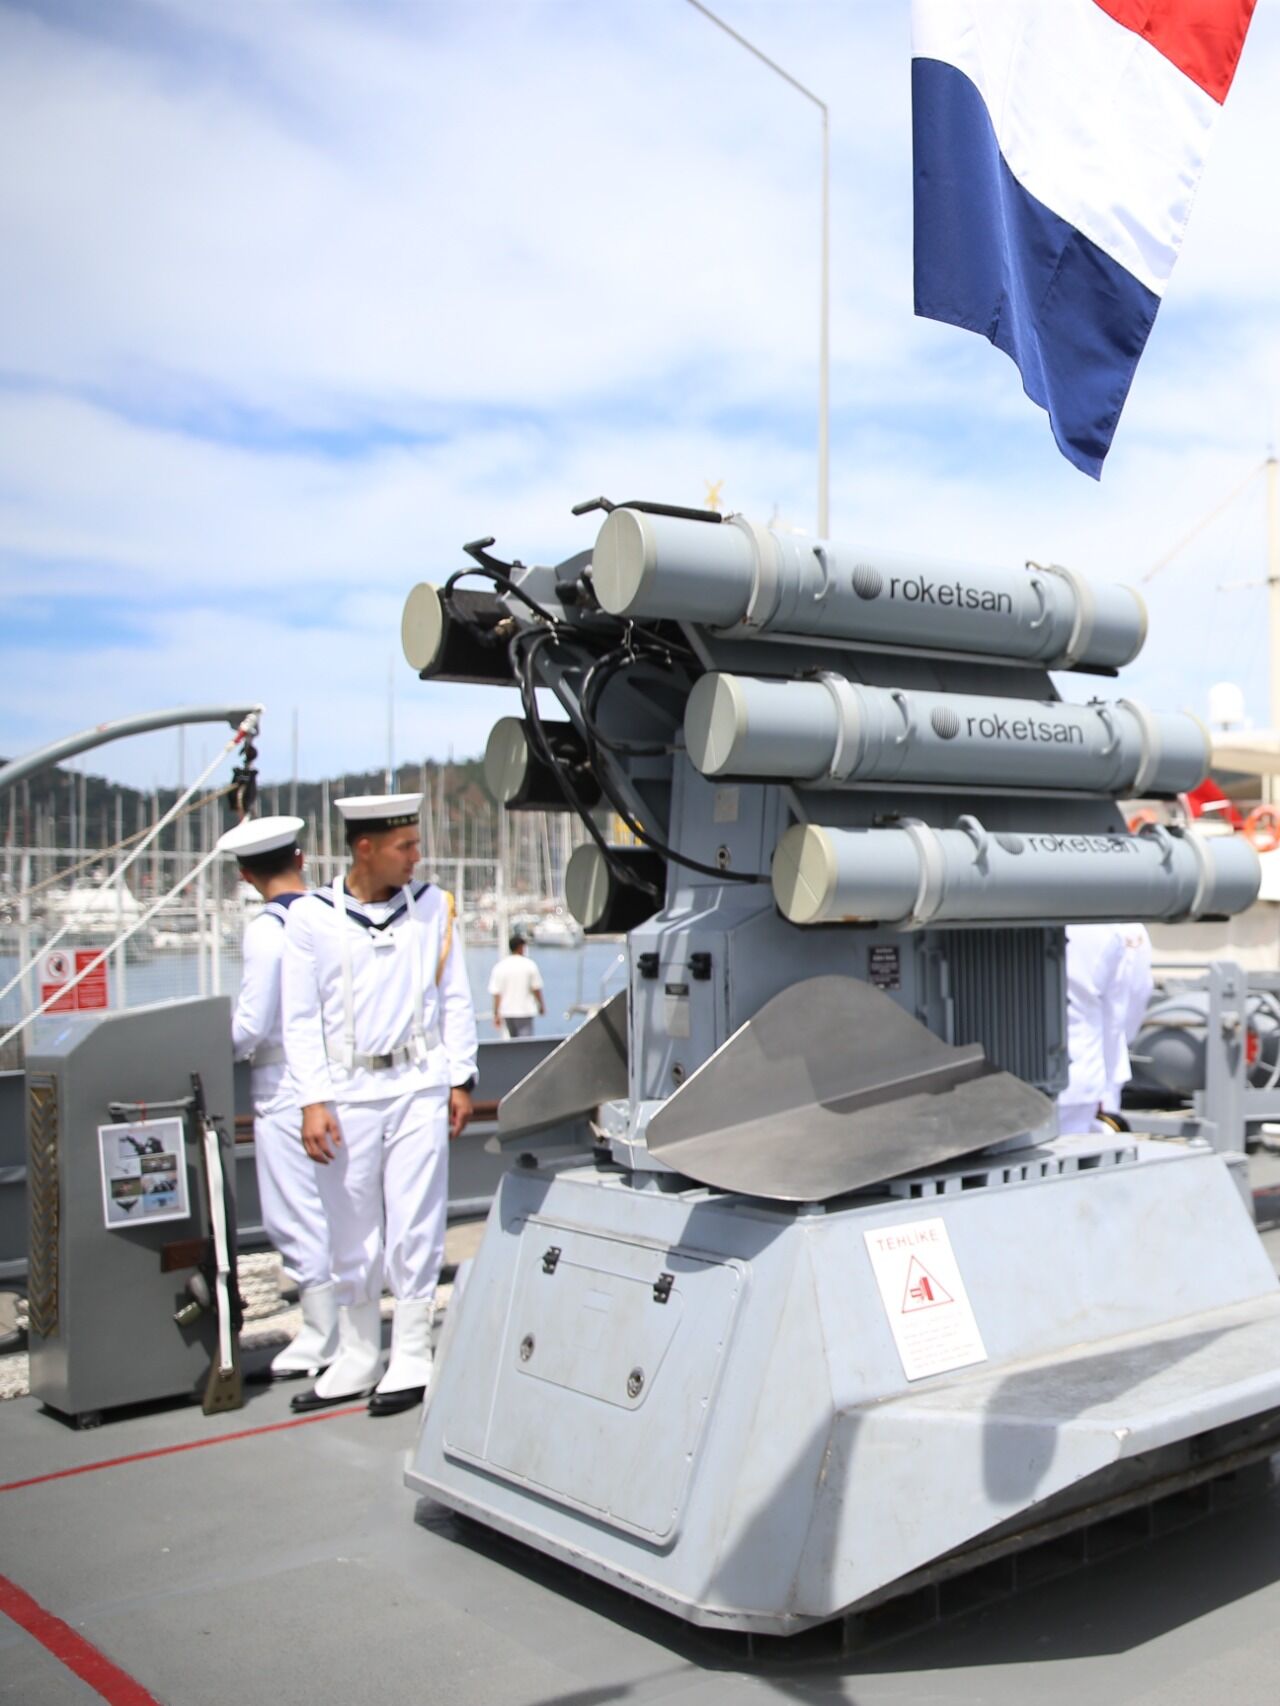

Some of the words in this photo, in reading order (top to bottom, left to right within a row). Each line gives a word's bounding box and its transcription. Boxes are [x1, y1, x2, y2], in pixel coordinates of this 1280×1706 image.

[889, 575, 1013, 614] roketsan
[966, 713, 1084, 745] roketsan
[1028, 833, 1139, 854] roketsan
